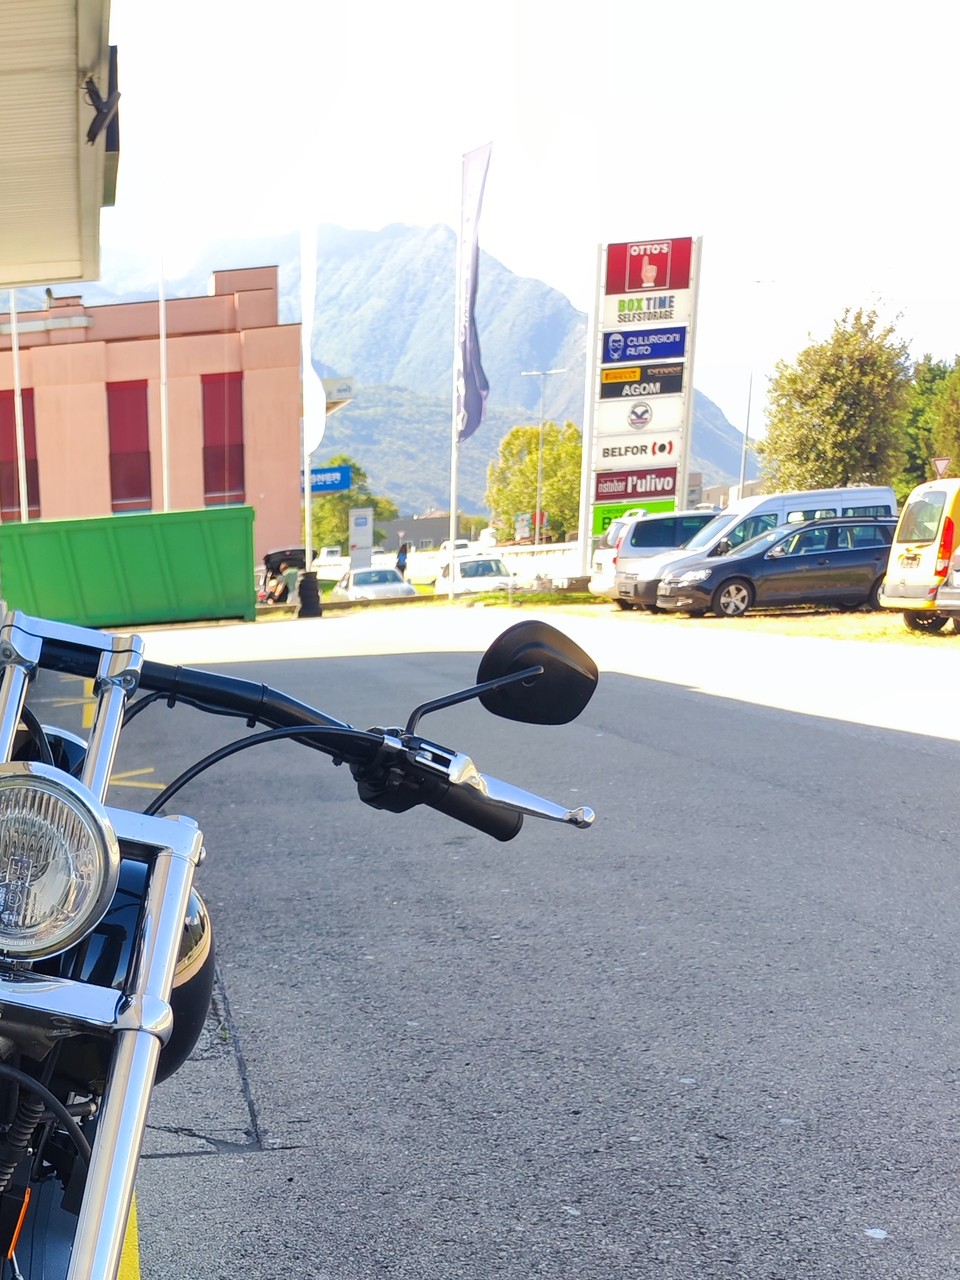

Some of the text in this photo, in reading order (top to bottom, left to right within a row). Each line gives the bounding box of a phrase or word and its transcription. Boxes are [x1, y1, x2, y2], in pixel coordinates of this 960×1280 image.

[630, 244, 669, 256] OTTO'S
[618, 295, 675, 312] BOX TIME
[617, 310, 674, 323] SELFSTORAGE
[621, 382, 661, 396] AGOM
[602, 445, 648, 458] BELFOR
